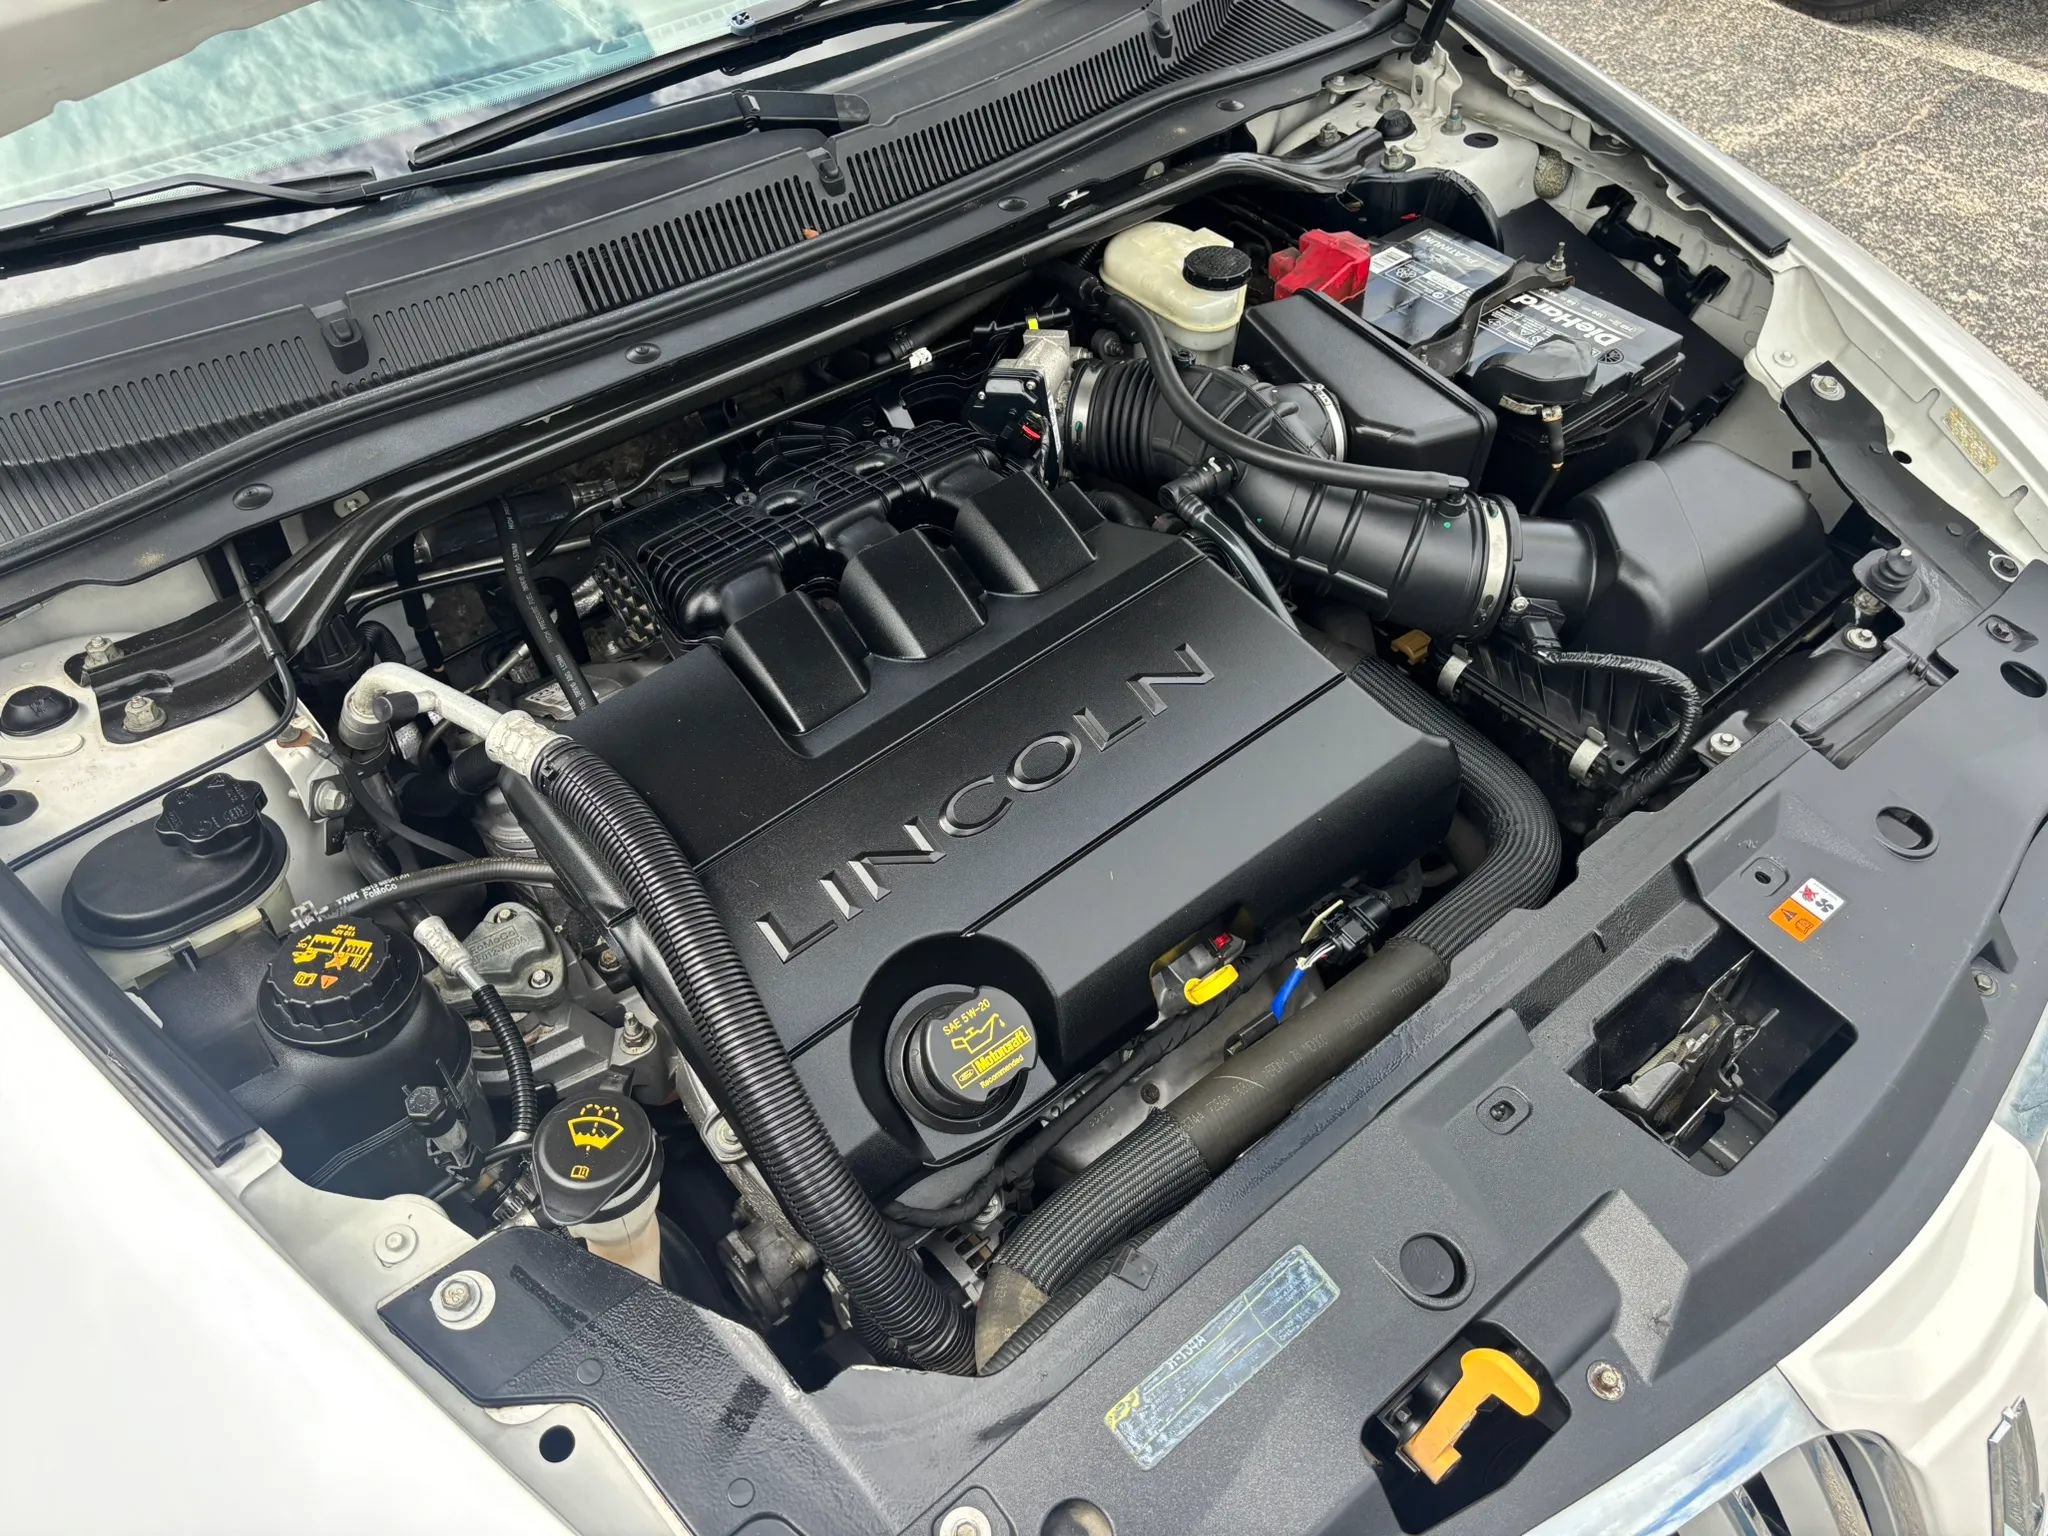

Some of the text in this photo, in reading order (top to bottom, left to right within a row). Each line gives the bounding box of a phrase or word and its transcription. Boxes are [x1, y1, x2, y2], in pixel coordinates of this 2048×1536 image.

[1420, 235, 1479, 263] PLATINUM
[1510, 294, 1622, 347] DieHard
[755, 643, 1215, 964] LINCOLN
[362, 883, 398, 900] FoMoCo
[942, 998, 991, 1036] SAE 5W-20
[979, 1053, 1024, 1089] Recommended
[1168, 1334, 1207, 1371] R-134A
